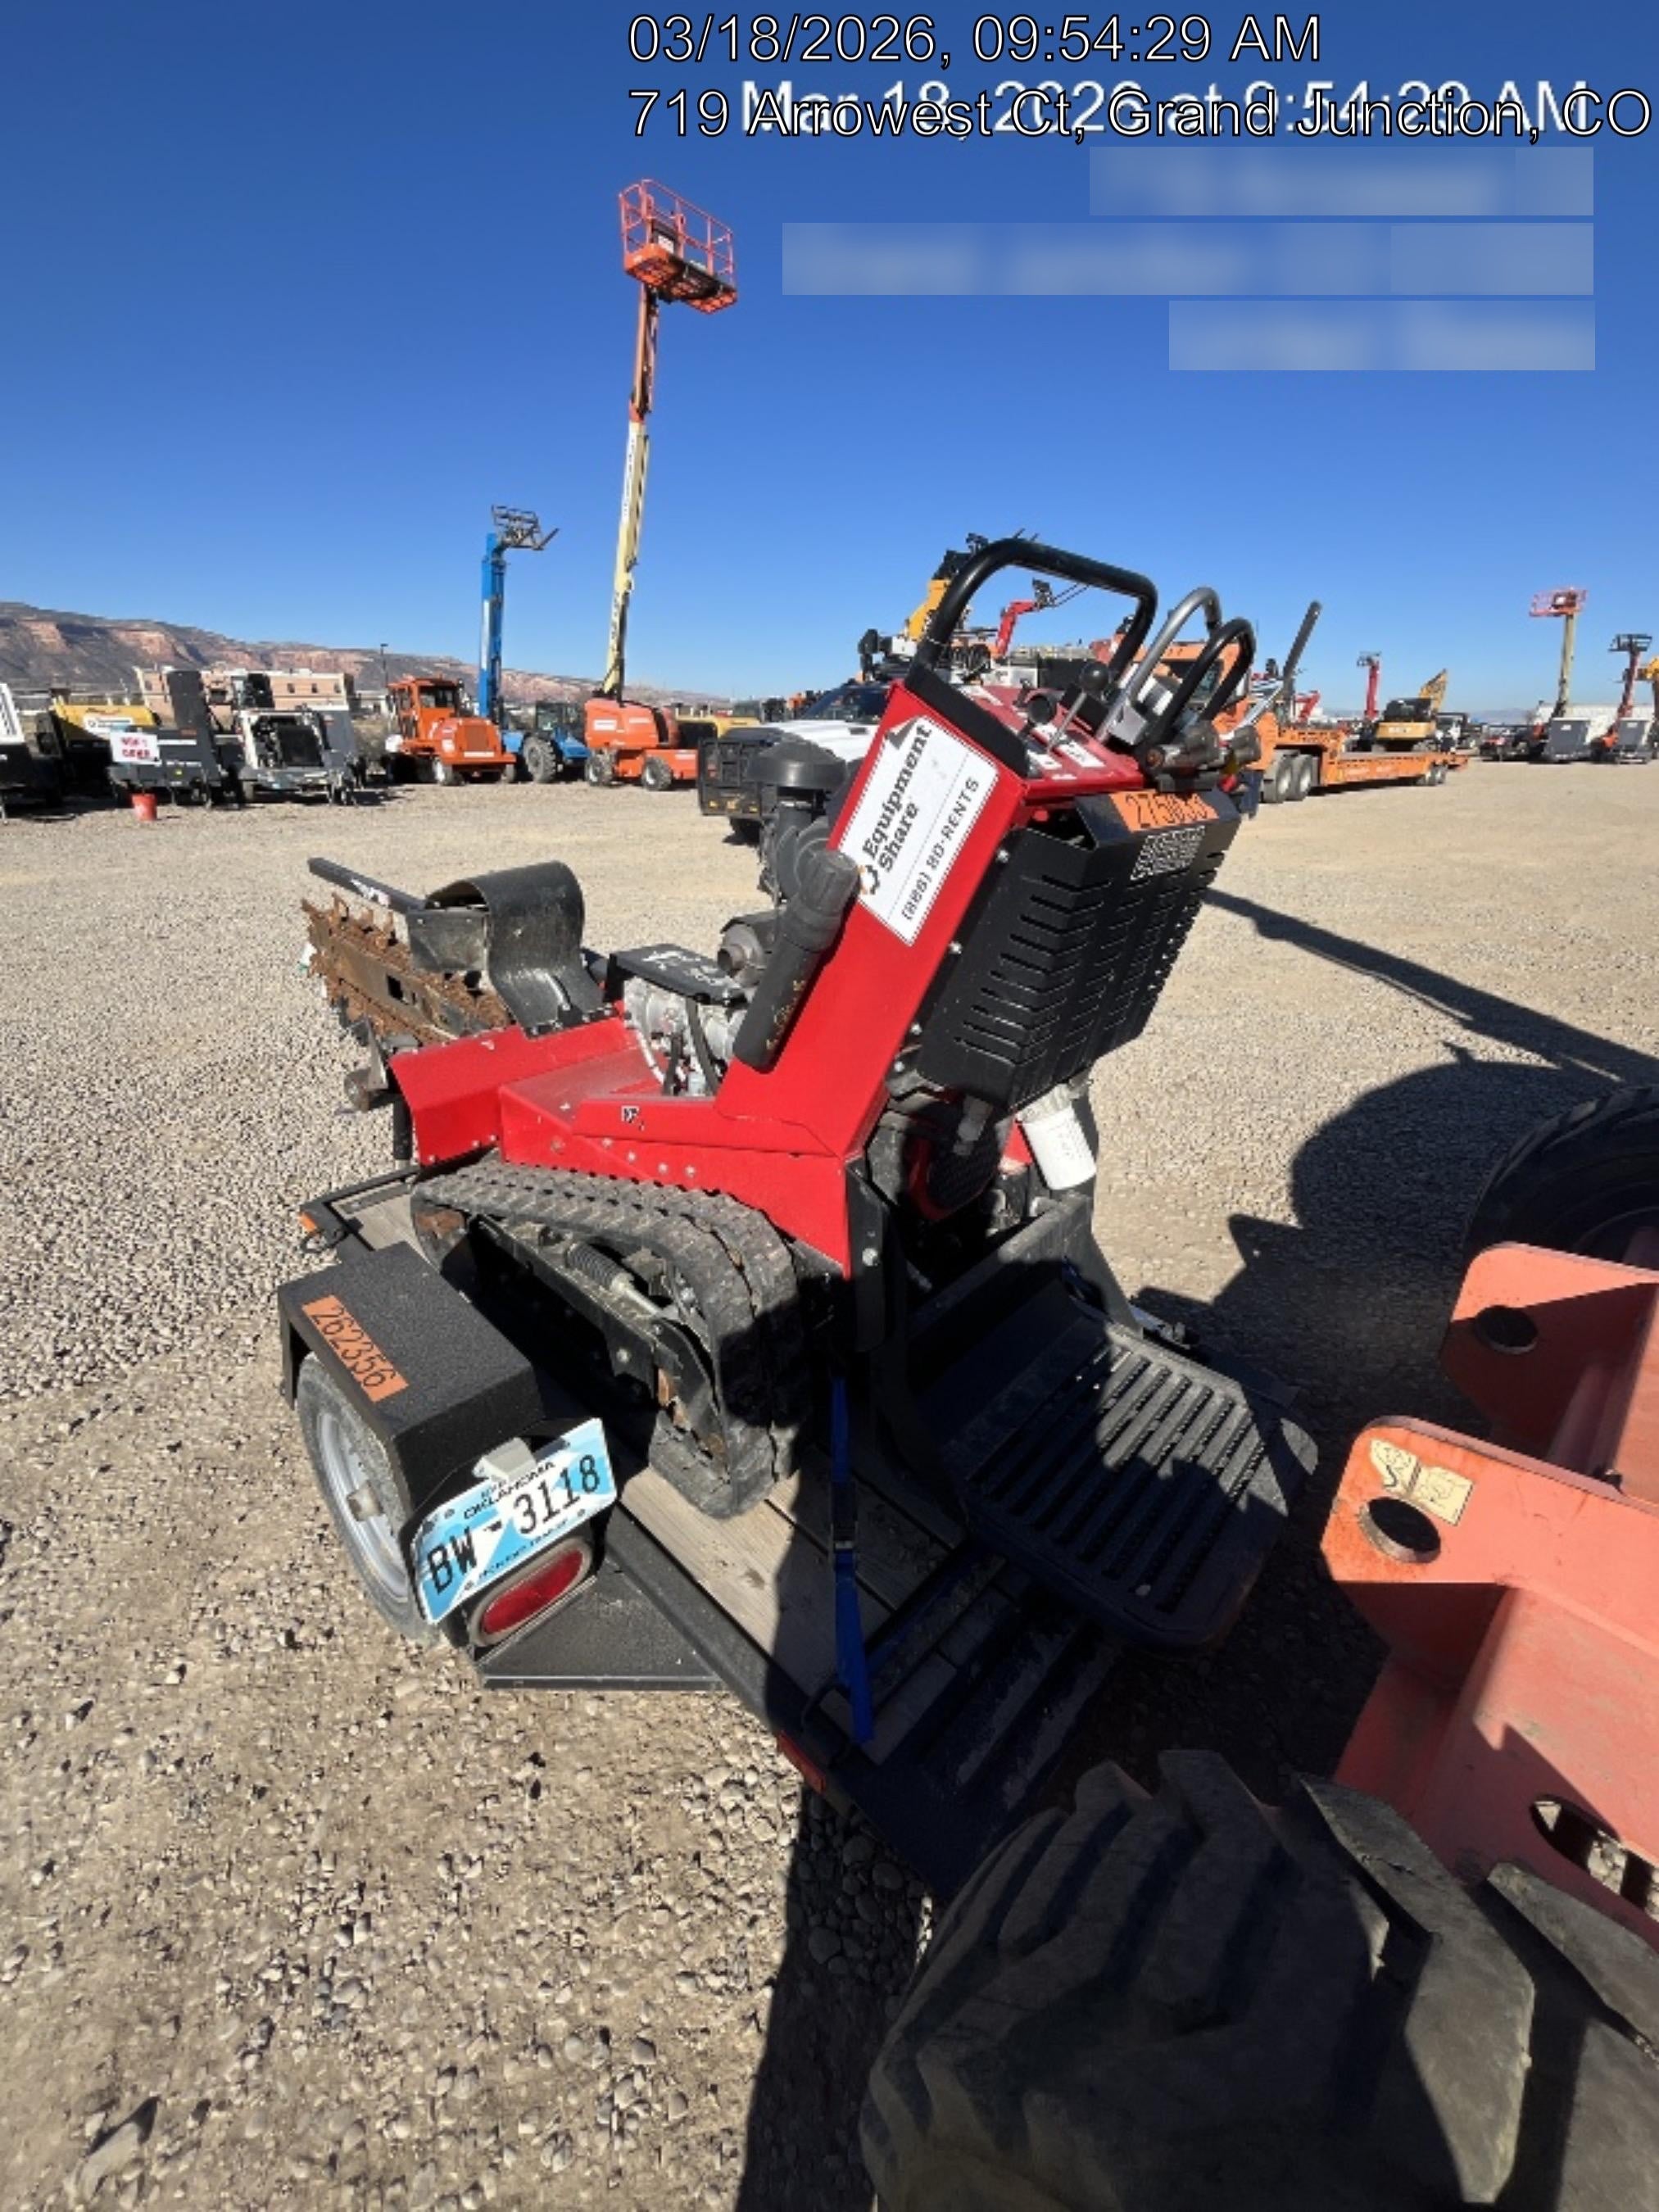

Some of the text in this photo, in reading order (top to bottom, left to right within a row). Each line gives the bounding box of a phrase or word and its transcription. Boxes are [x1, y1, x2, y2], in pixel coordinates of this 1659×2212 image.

[862, 723, 932, 861] Equipment
[879, 801, 920, 873] Share
[310, 1307, 397, 1386] 262356
[513, 1454, 601, 1534] 3118
